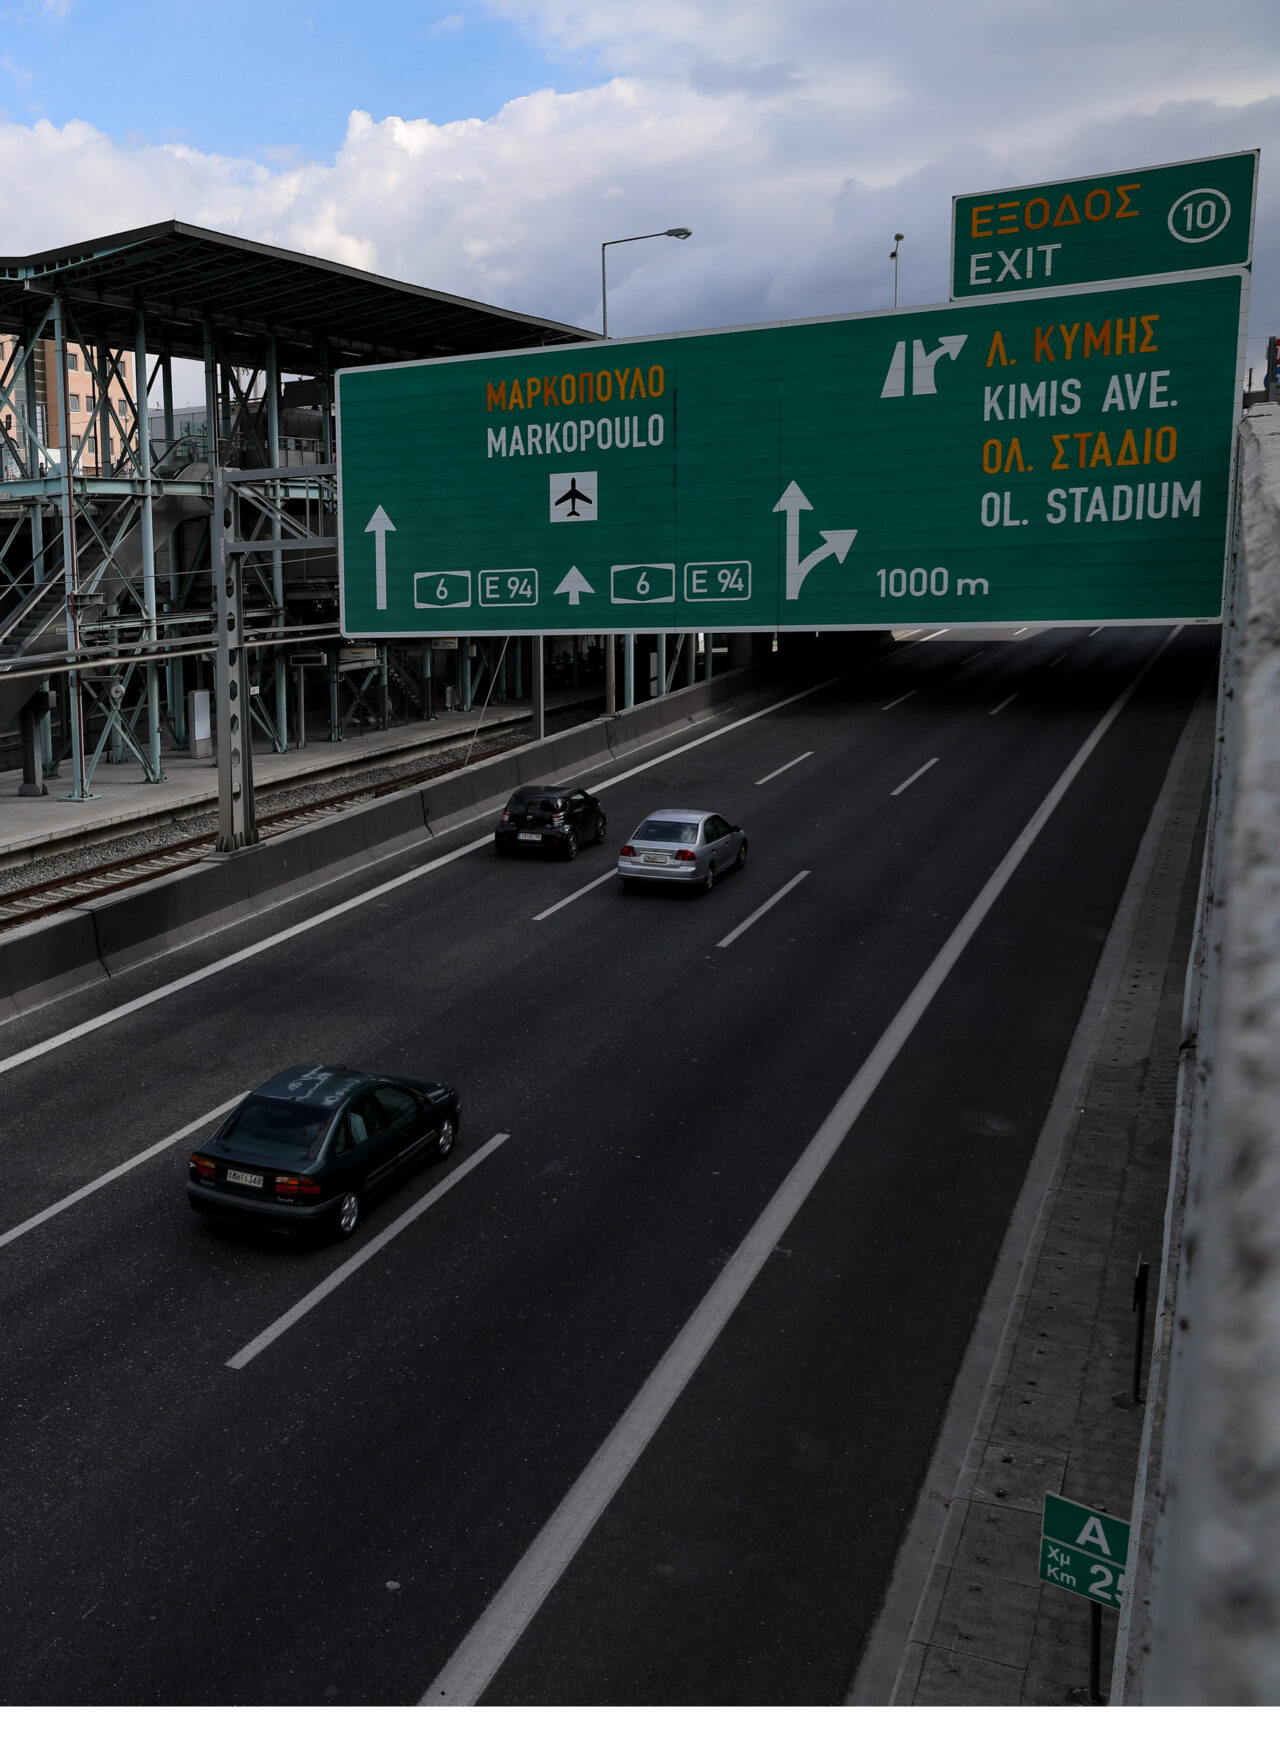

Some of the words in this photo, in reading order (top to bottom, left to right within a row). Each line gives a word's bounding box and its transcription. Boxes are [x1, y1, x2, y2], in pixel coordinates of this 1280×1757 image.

[970, 183, 1142, 238] ΕΞΟΔΟΣ
[1181, 200, 1218, 232] 10
[970, 244, 1062, 286] EXIT
[986, 331, 1016, 368] Λ.
[1034, 314, 1160, 362] ΚΥΜΗΣ
[486, 365, 665, 412] ΜΑΡΚΟΠΟΥΛΟ
[984, 378, 1081, 421] KIMIS
[1102, 370, 1177, 412] AVE.
[487, 413, 664, 458] MARKOPOULO
[982, 437, 1033, 474] ΟΛ.
[1051, 425, 1177, 470] ΣΤΑΔΙΟ
[981, 491, 1028, 527] OL.
[1046, 480, 1201, 524] STADIUM
[436, 578, 448, 600] 6
[486, 576, 500, 598] E
[506, 576, 533, 598] 94
[636, 572, 650, 595] 6
[692, 570, 708, 593] E
[716, 569, 744, 593] 94
[877, 567, 949, 598] 1000
[957, 578, 989, 596] m
[1046, 1563, 1077, 1587] Km
